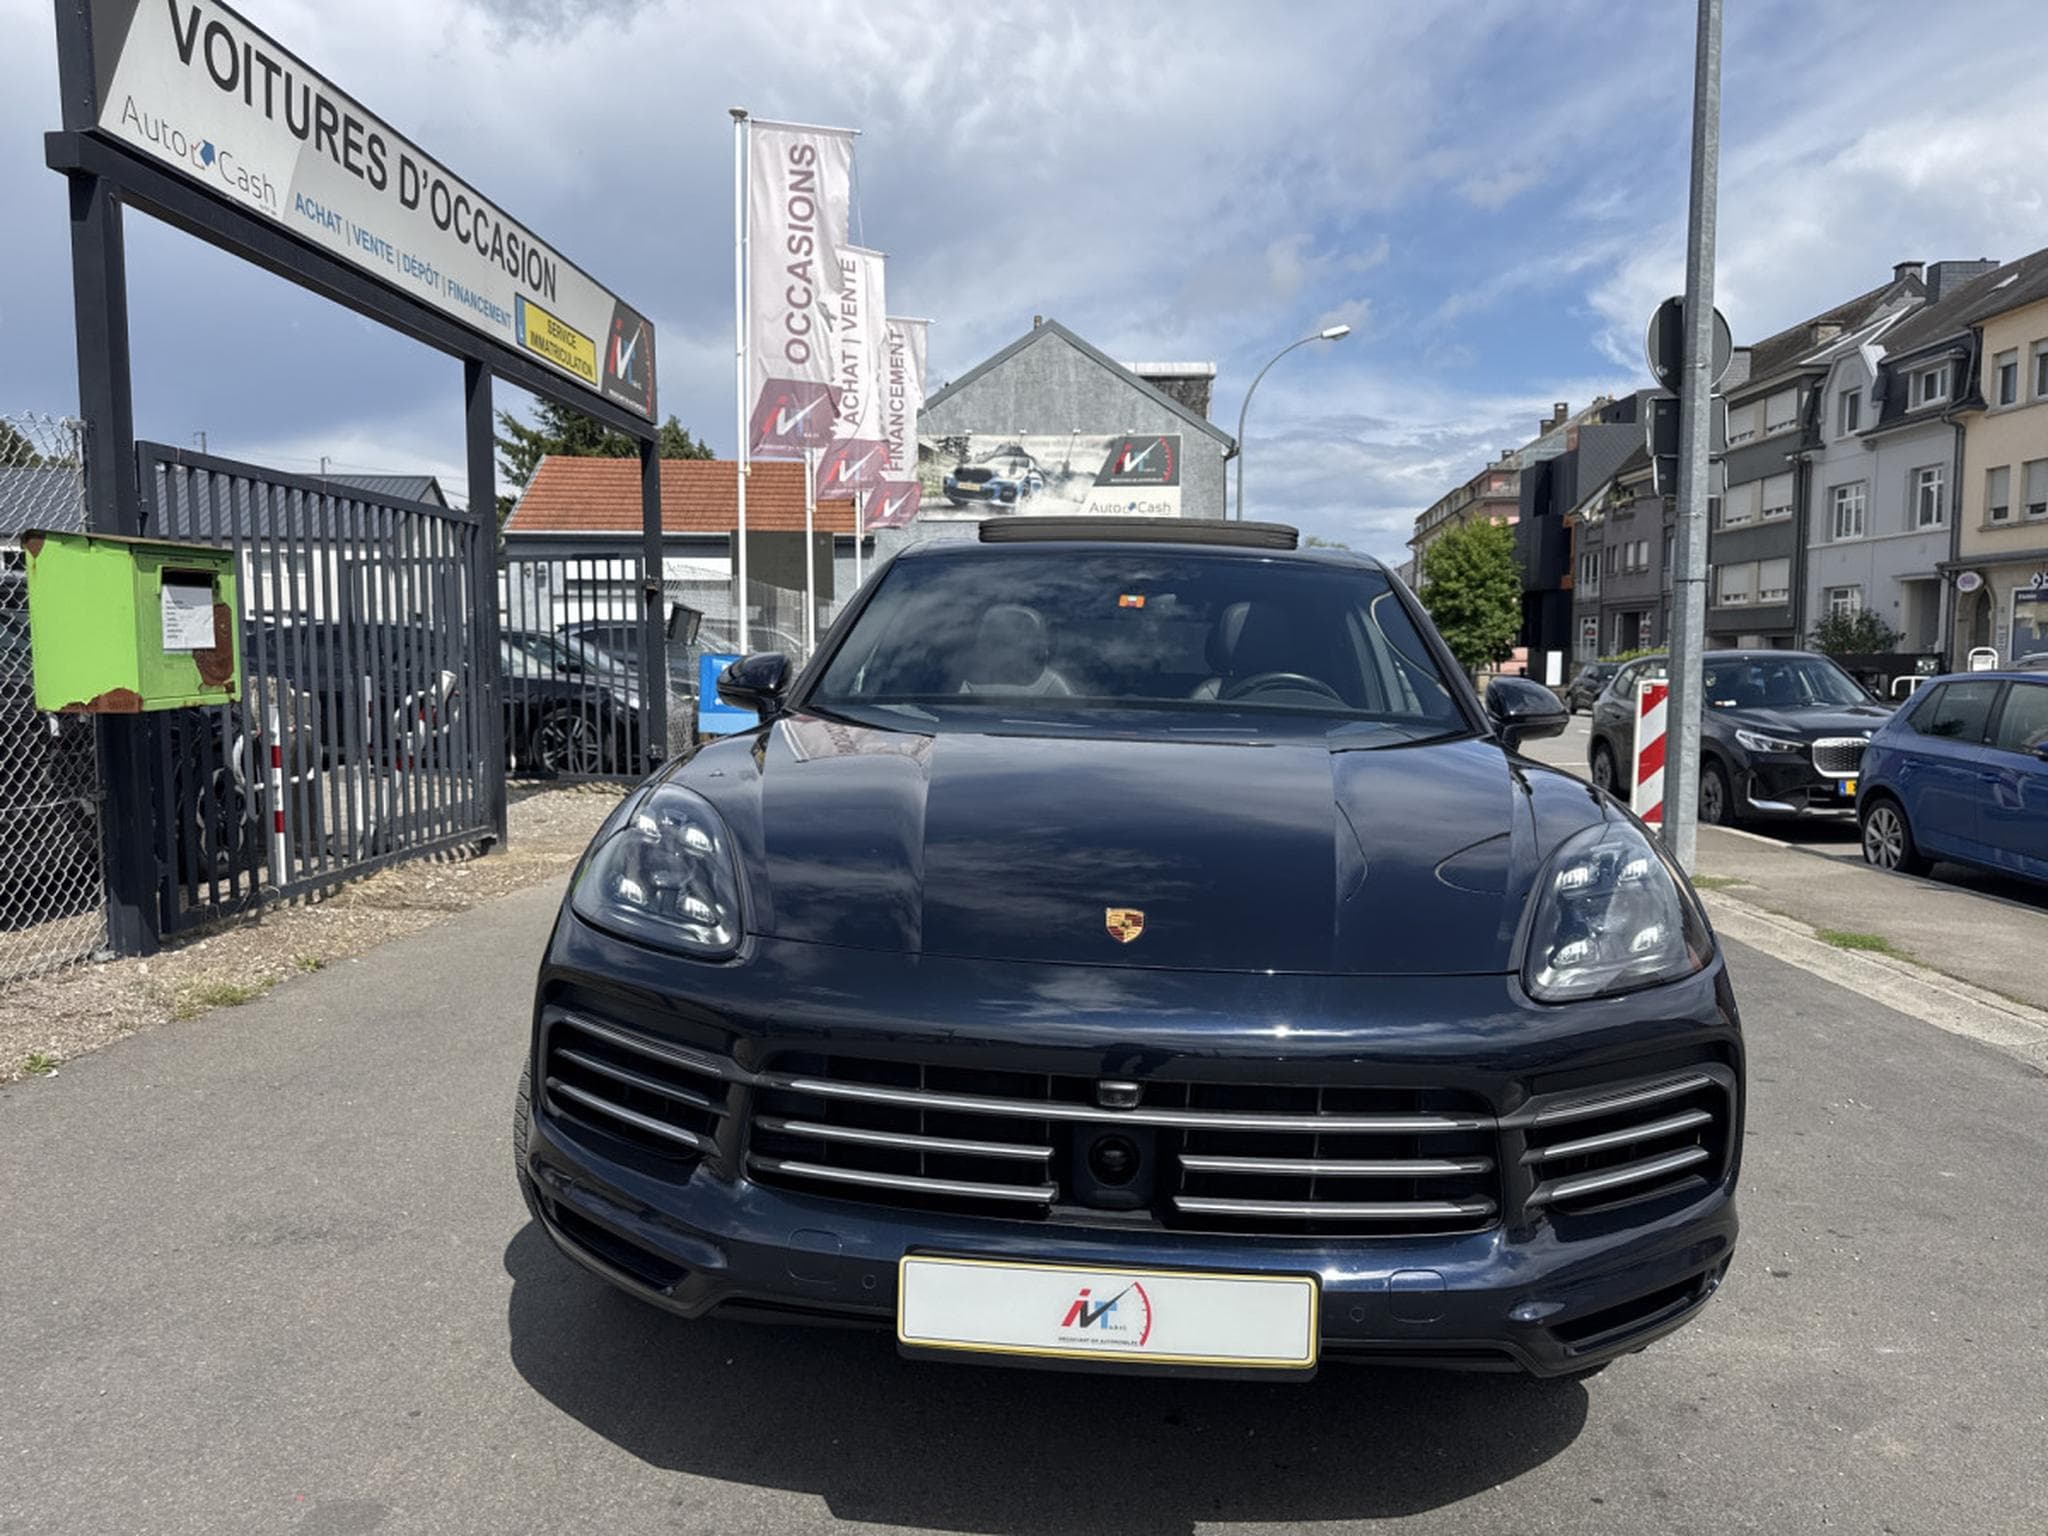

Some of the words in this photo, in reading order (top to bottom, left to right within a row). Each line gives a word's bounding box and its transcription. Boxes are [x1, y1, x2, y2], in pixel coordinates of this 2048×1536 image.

[122, 95, 187, 158] Auto
[219, 151, 277, 208] Cash
[168, 0, 388, 192] VOITURES
[400, 153, 556, 303] D'OCCASION
[295, 192, 342, 235] ACHAT
[352, 225, 394, 264] VENTE
[403, 252, 439, 288] DÉPÔT
[448, 279, 512, 329] FINANCEMENT
[785, 143, 816, 365] OCCASIONS
[840, 258, 857, 332] VENTE
[529, 331, 593, 377] IMMATRICULATION
[547, 318, 577, 349] SERVICE
[841, 349, 860, 427] ACHAT
[888, 328, 905, 472] FINANCEMENT
[1088, 501, 1121, 514] Auto
[1138, 501, 1172, 514] Cash
